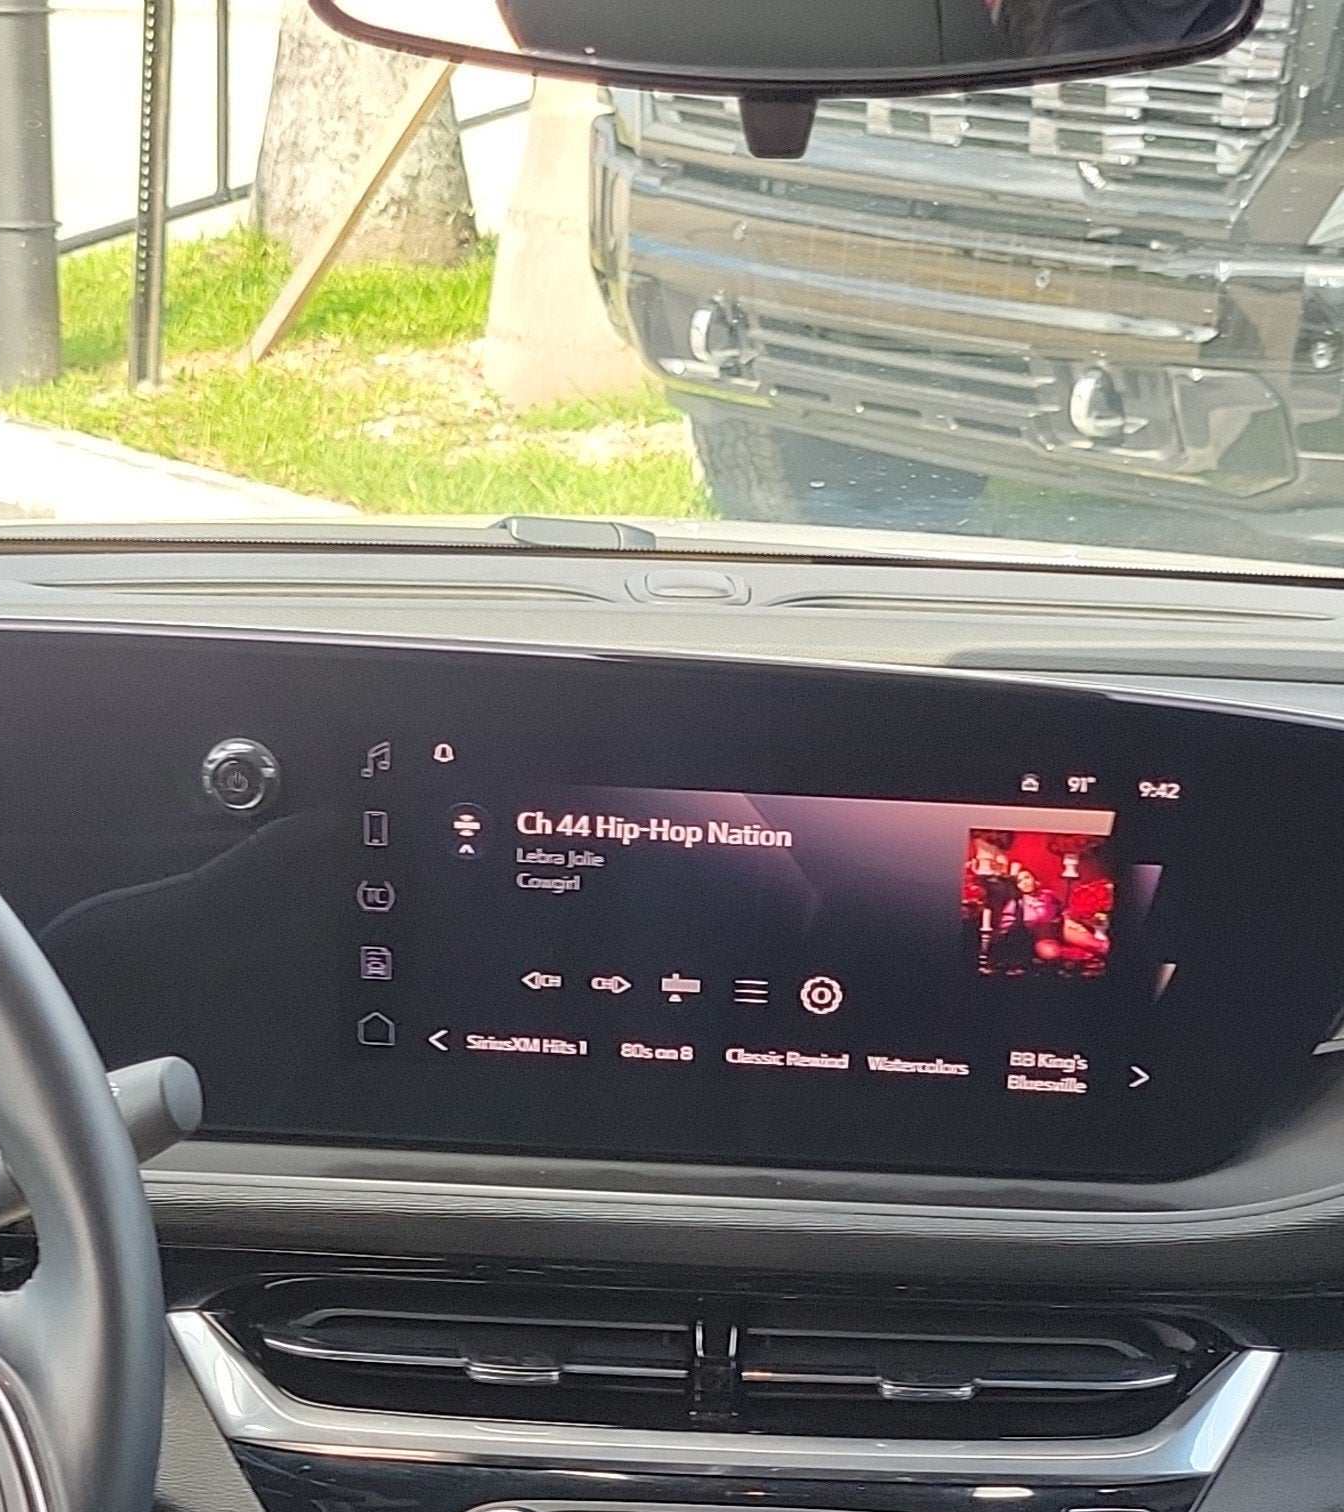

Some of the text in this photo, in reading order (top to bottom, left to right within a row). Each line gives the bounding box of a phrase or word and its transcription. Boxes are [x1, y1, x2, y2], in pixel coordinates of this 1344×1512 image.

[1138, 781, 1181, 799] 9:42
[516, 811, 792, 847] Ch 44 Hip-Hop Nation
[516, 848, 605, 868] Lebra Jolie
[516, 873, 581, 894] Cowgirl
[466, 1034, 541, 1054] SiriusXM
[543, 1039, 577, 1055] Hits
[621, 1043, 693, 1061] 80s on 8
[725, 1048, 850, 1069] Classic Rewind
[866, 1055, 970, 1076] Watercolors
[1037, 1054, 1088, 1073] King's
[1008, 1074, 1088, 1093] Bluesville
